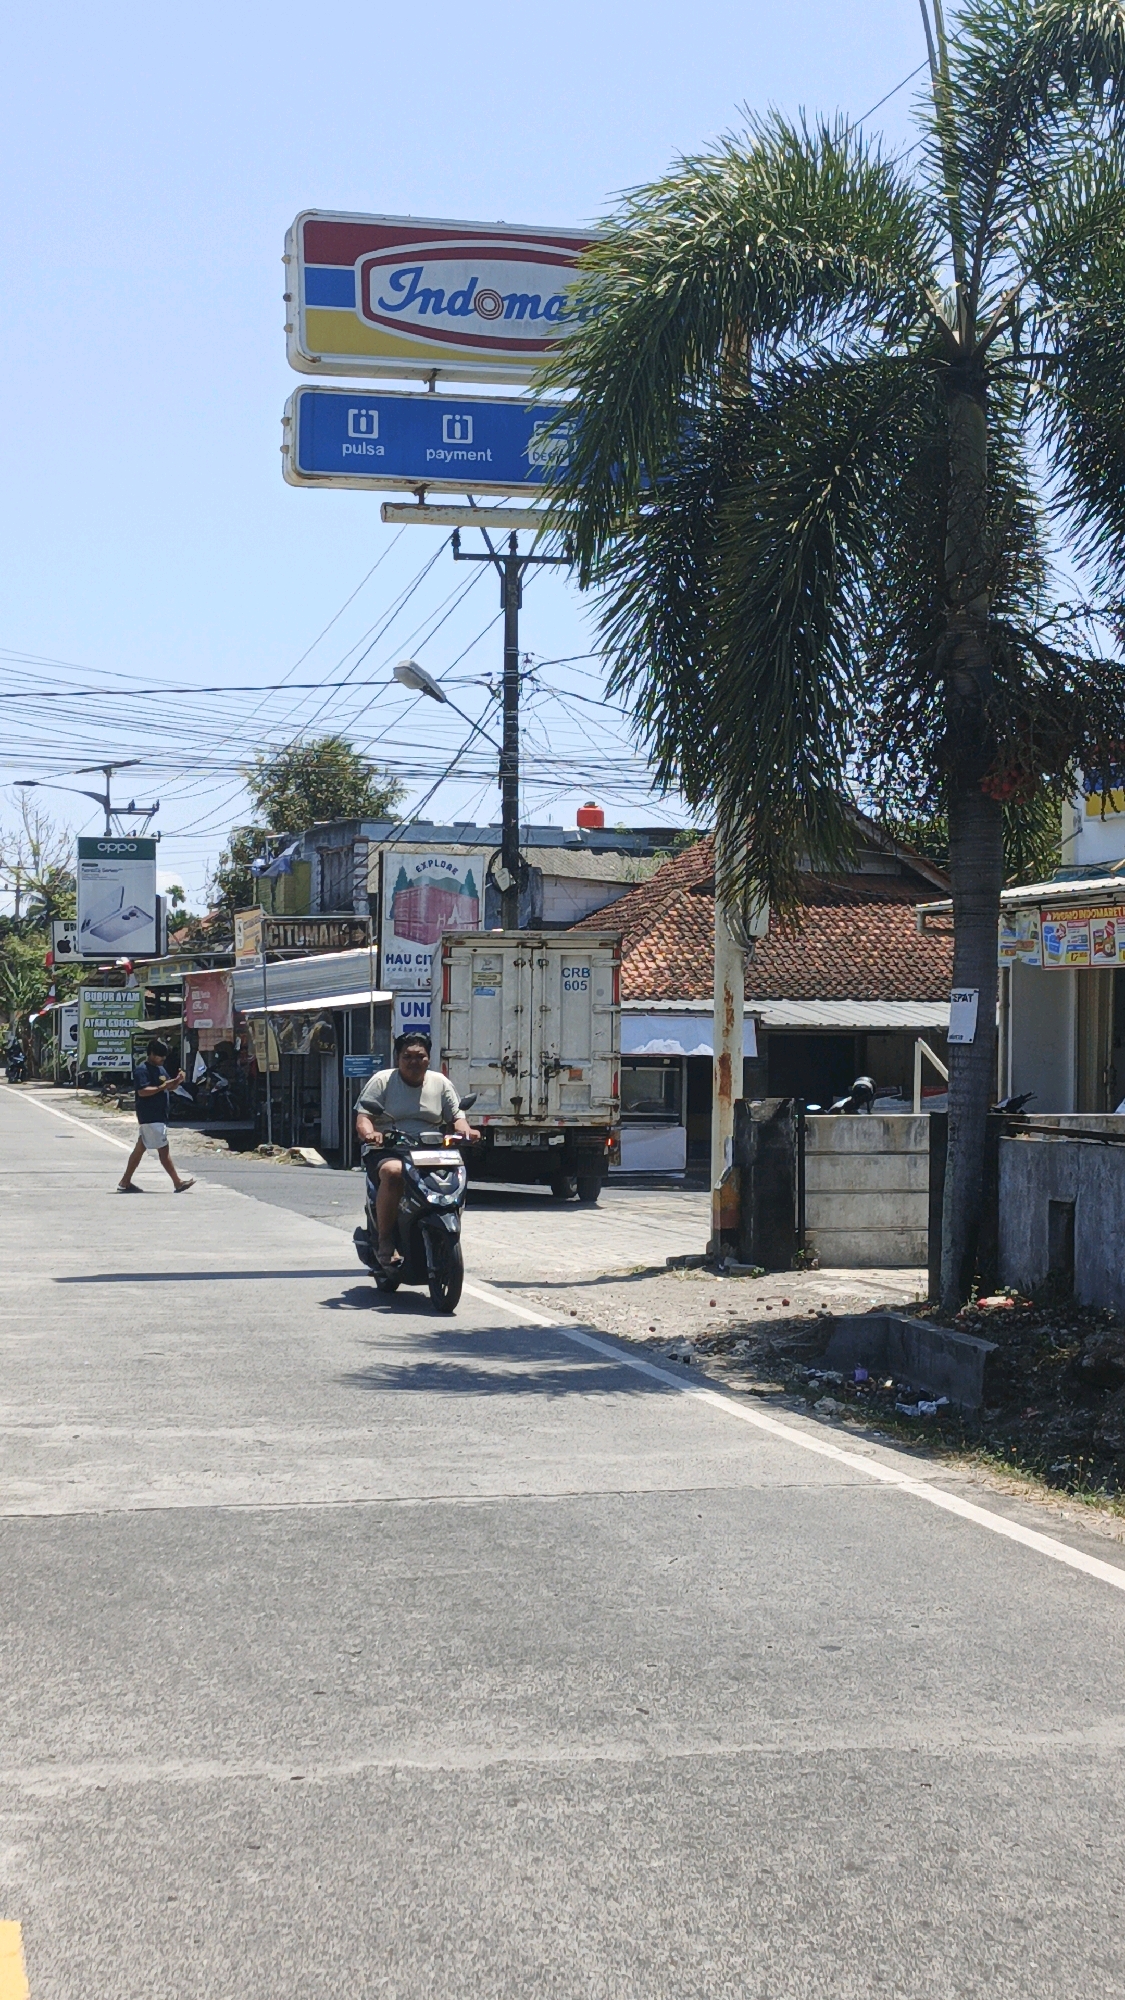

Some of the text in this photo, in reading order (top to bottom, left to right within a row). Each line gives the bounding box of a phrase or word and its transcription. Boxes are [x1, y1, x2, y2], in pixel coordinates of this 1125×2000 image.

[342, 442, 385, 459] pulsa
[426, 447, 493, 463] payment
[415, 859, 459, 876] EXPLORE
[267, 923, 350, 947] CITUMANG
[385, 953, 412, 965] HAU
[561, 967, 591, 979] CRB
[564, 980, 588, 991] 605
[84, 991, 140, 1002] BUBUR AYAM
